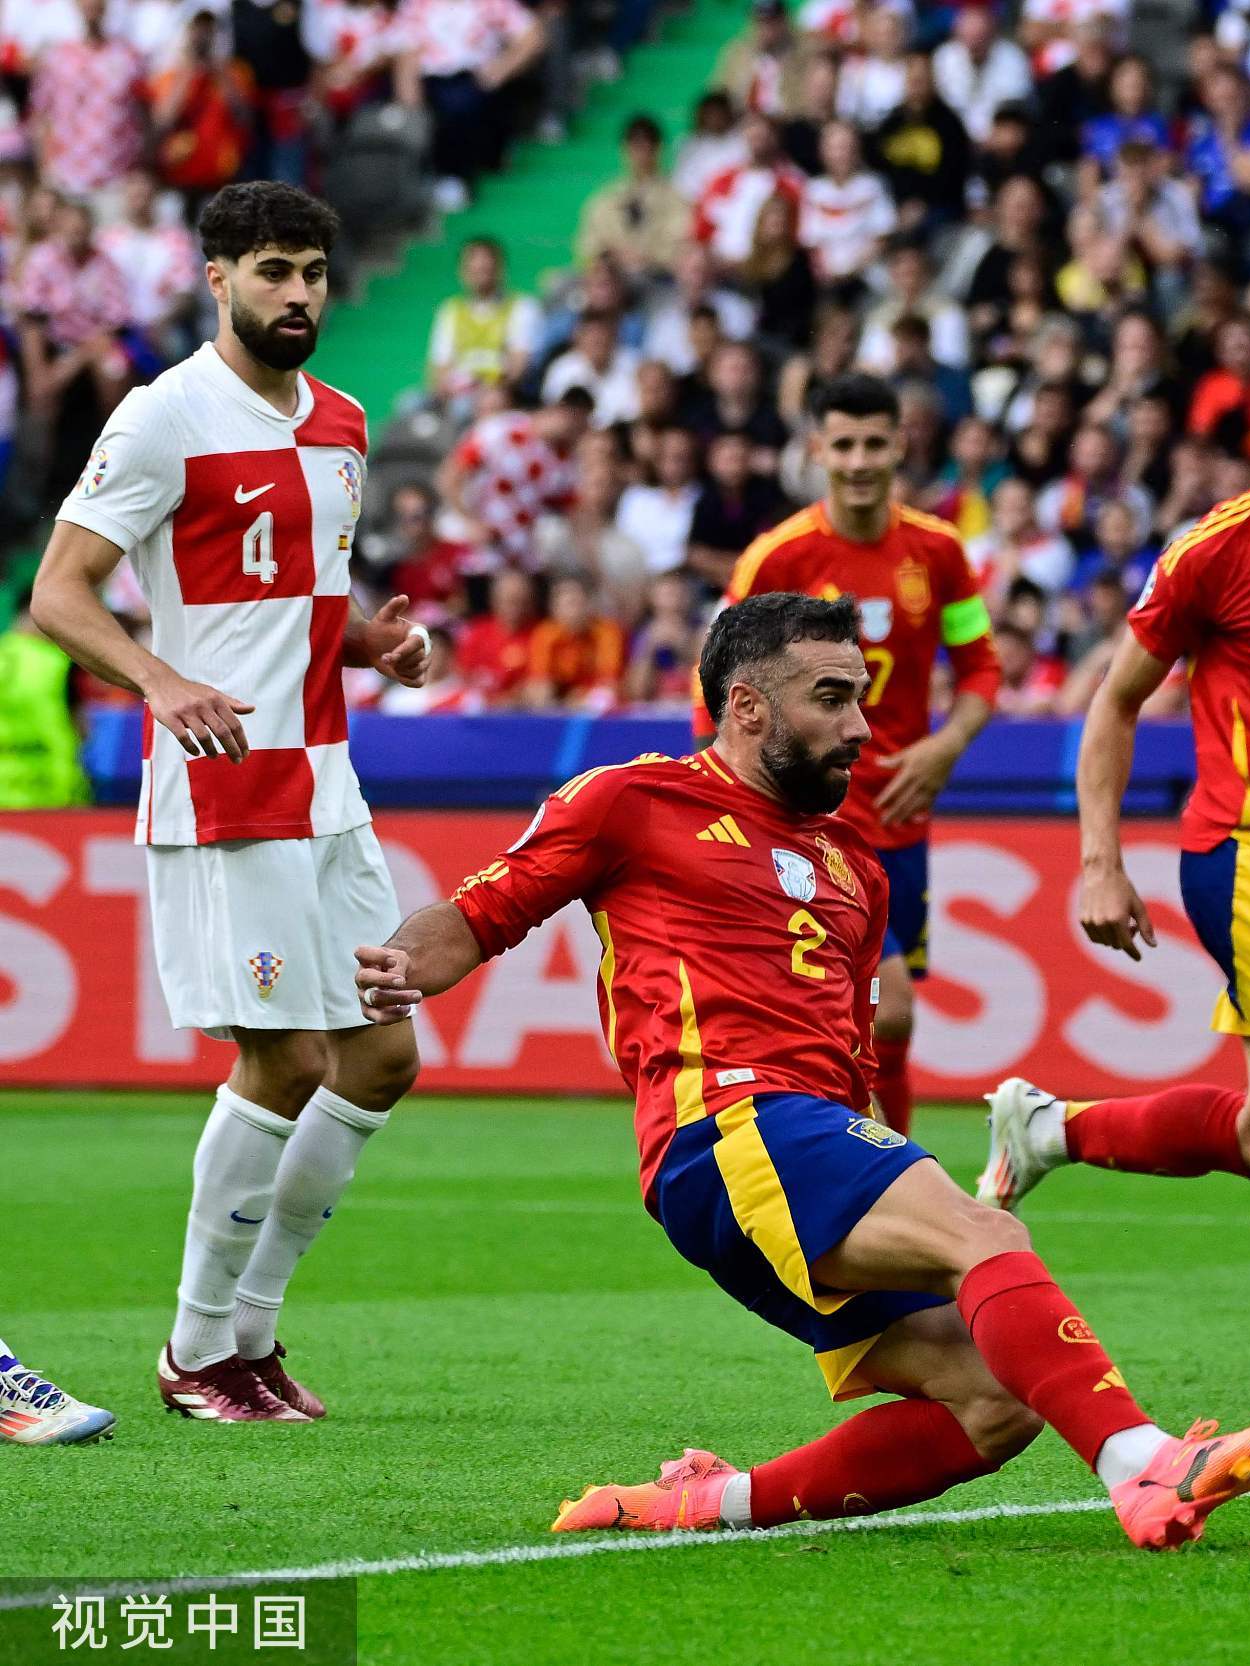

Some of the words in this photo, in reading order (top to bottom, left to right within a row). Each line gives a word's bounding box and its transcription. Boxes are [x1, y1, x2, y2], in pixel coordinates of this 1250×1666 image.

[242, 510, 279, 585] 4
[864, 647, 895, 707] 7
[787, 908, 827, 980] 2
